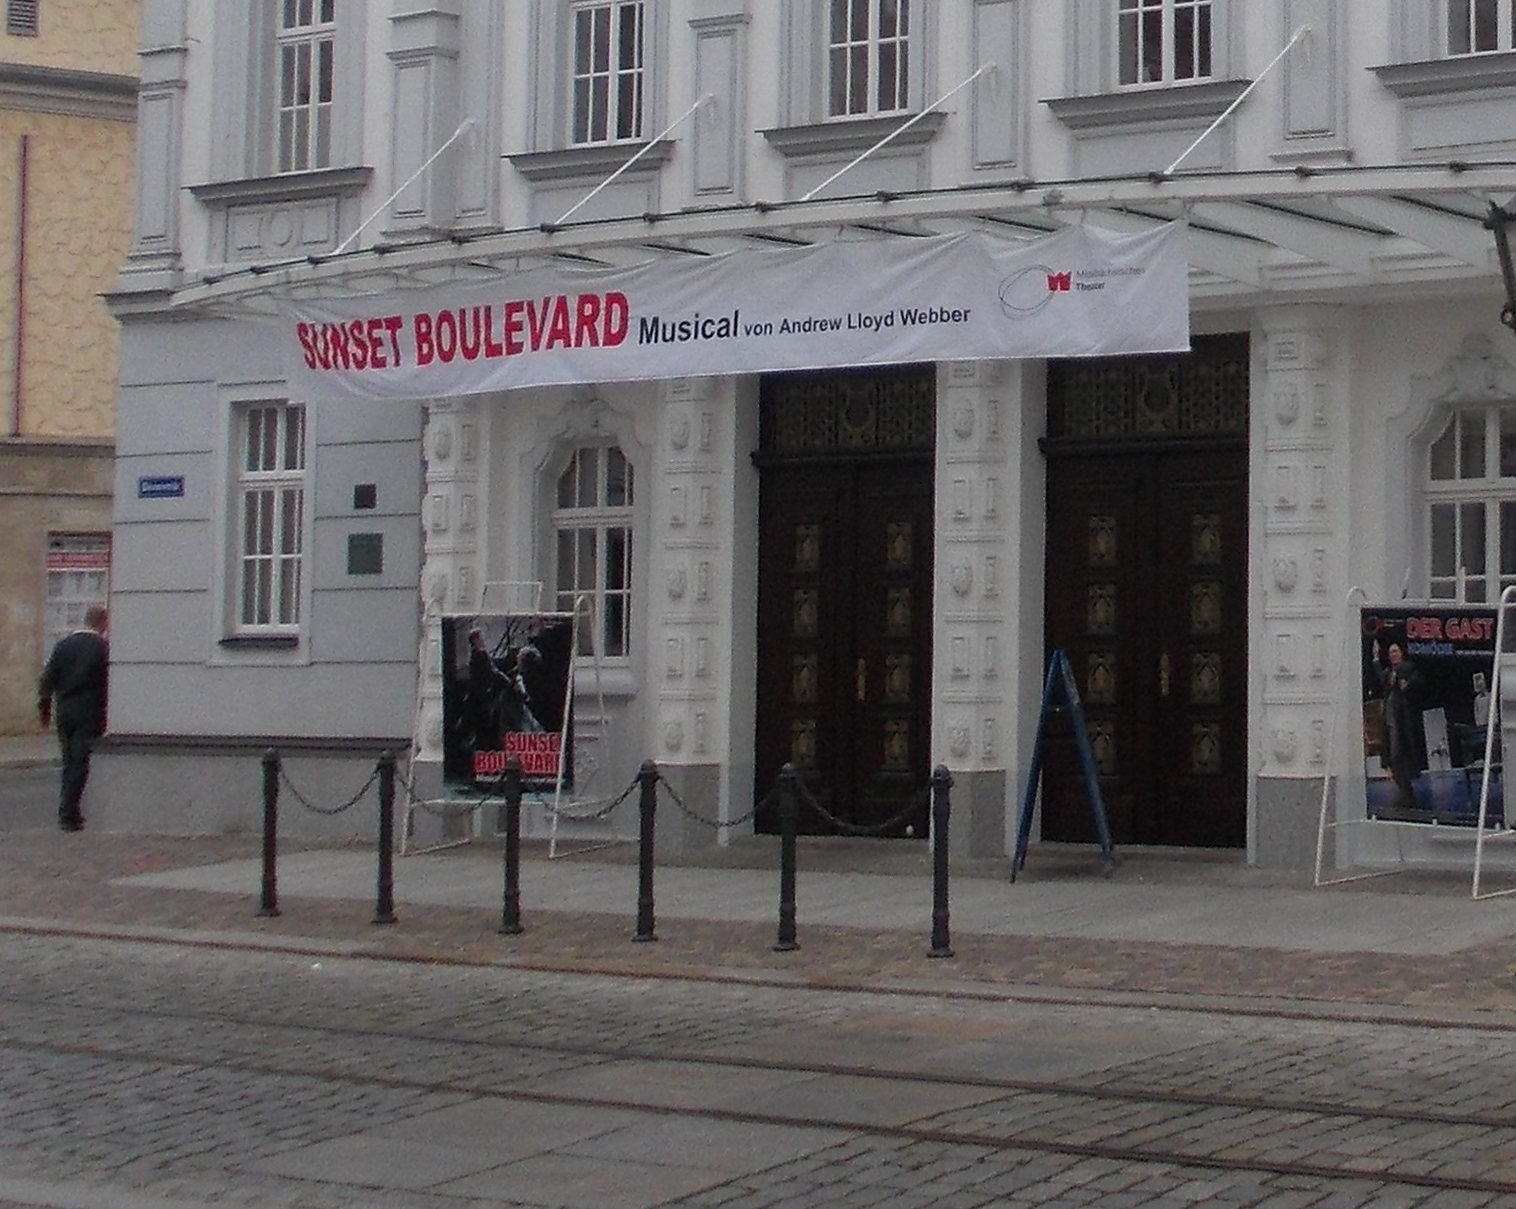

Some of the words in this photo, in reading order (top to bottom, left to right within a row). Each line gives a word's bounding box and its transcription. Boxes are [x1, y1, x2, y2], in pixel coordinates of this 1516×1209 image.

[297, 317, 402, 371] SUNSET
[414, 292, 630, 366] BOULEVARD
[639, 310, 739, 345] Musical
[744, 323, 773, 337] von
[779, 317, 842, 334] Andrew
[848, 310, 894, 332] Lloyd
[900, 306, 970, 326] Webber
[1407, 617, 1443, 639] DER
[1446, 617, 1494, 640] GAST
[505, 731, 563, 752] SUNSE
